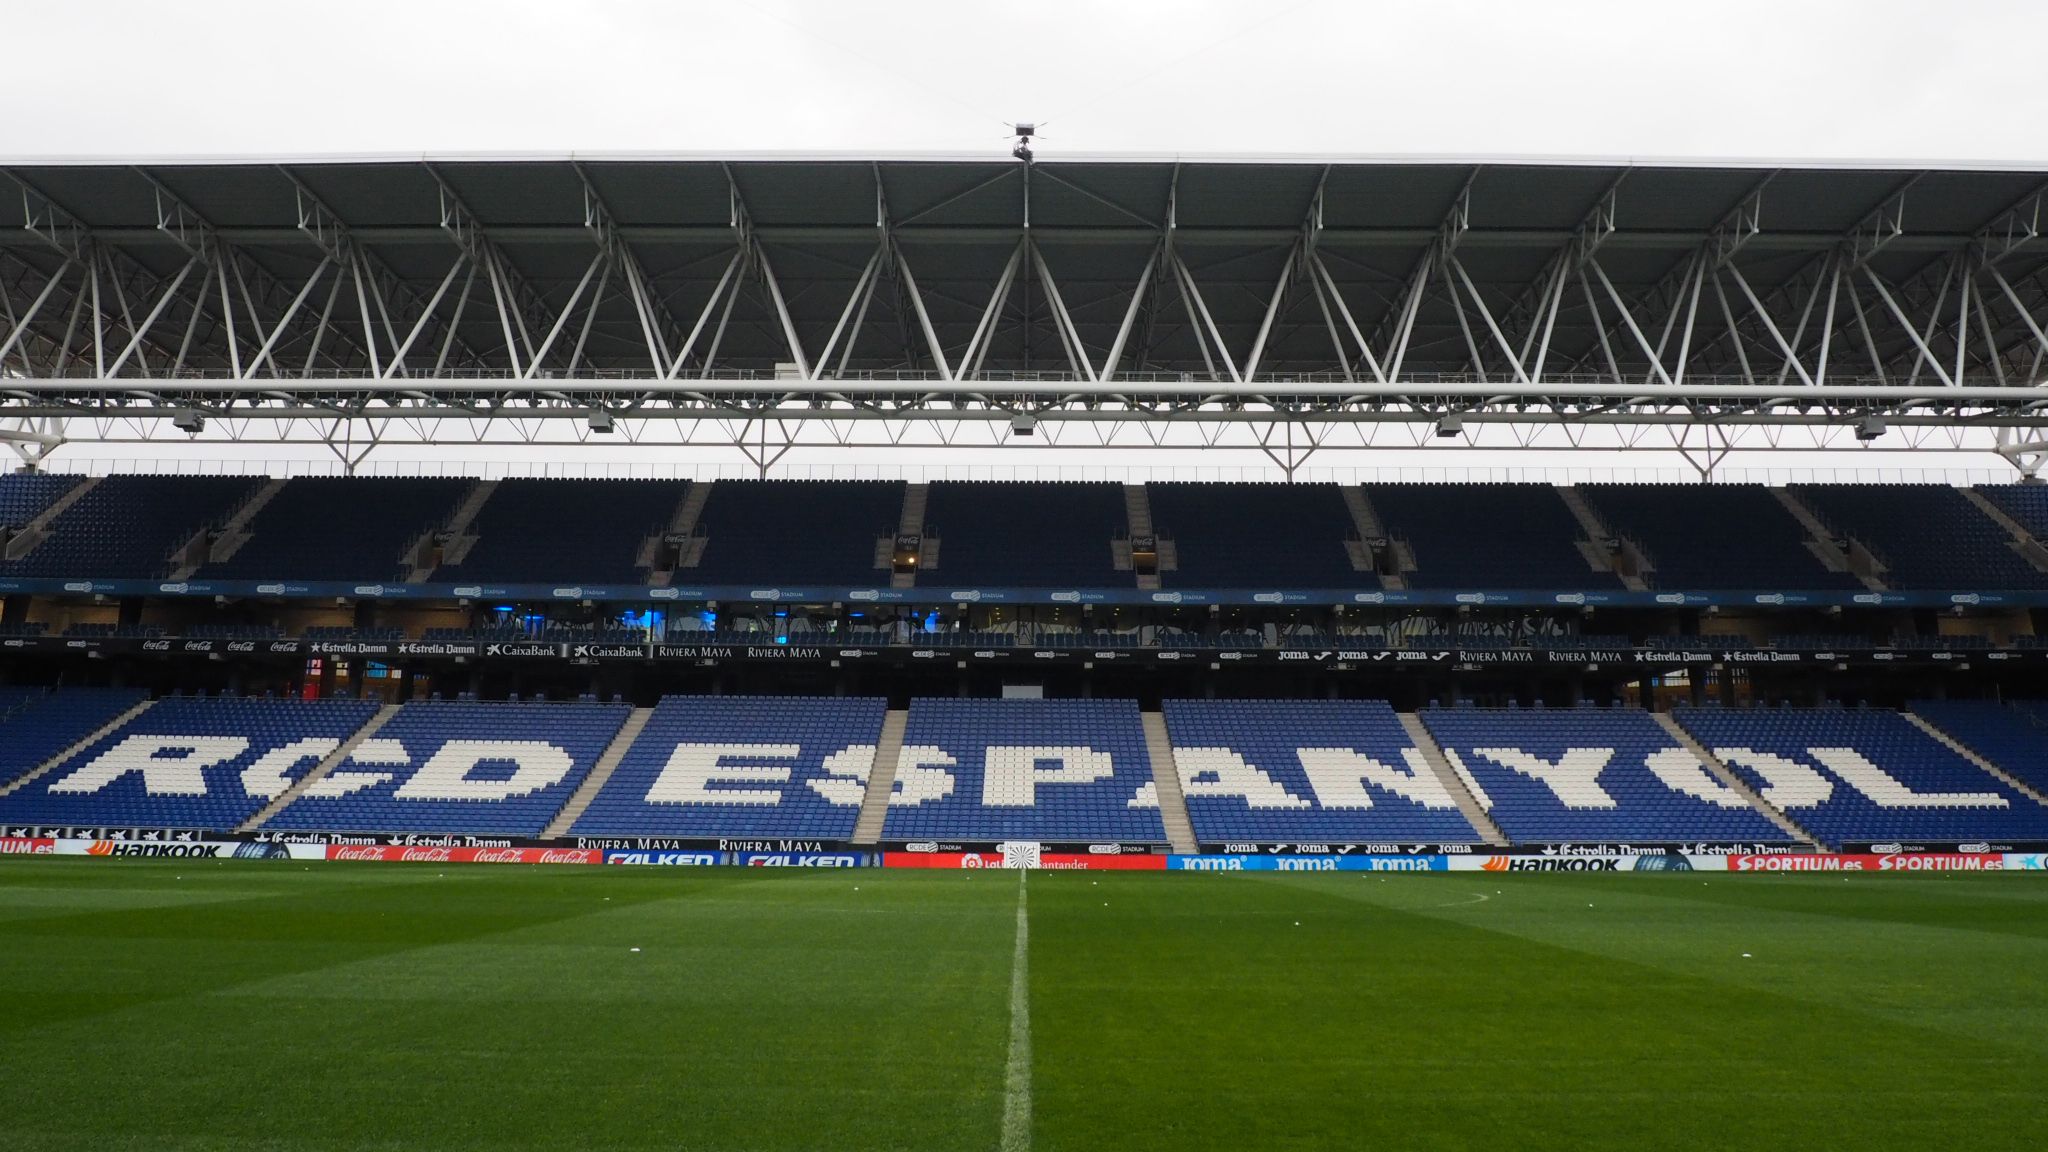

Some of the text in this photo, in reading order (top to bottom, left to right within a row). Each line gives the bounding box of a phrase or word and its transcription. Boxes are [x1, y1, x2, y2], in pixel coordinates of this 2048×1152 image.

[321, 642, 387, 654] Estrella Damm
[409, 643, 475, 655] Estrella Damm
[502, 645, 555, 656] CaixaBank
[590, 646, 643, 657] CaixaBank
[659, 647, 732, 658] RIVIERA MAYA
[748, 647, 821, 658] RIVIERA MAYA
[1459, 651, 1533, 662] RIVIERA MAYA
[1549, 651, 1622, 662] RIVIERA MAYA
[1645, 652, 1712, 662] Estrella Damm
[1733, 651, 1800, 662] Estrella Damm
[48, 735, 2010, 811] RCD ESPANYOL
[578, 838, 680, 850] RIVIERA MAYA
[719, 840, 822, 852] RIVIERA MAYA
[608, 853, 713, 865] FALKEN
[748, 855, 854, 867] FALKEN
